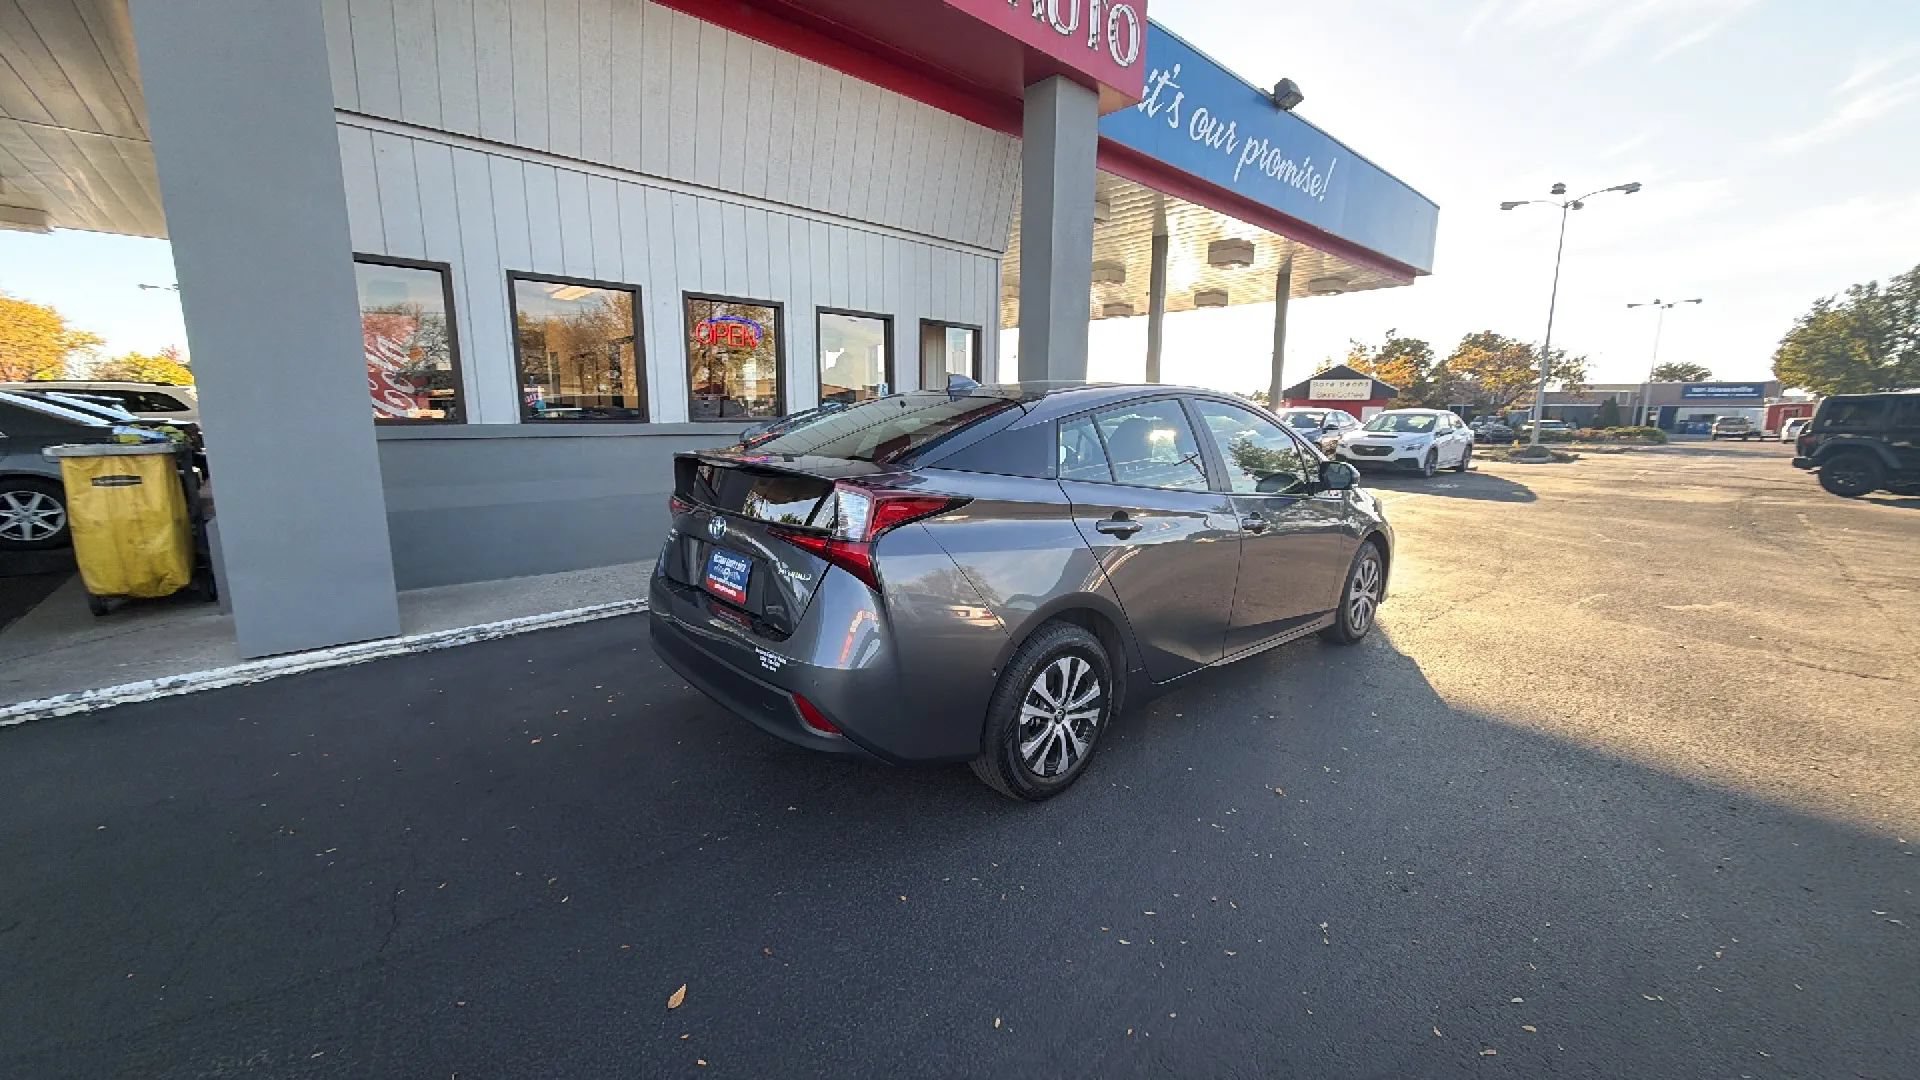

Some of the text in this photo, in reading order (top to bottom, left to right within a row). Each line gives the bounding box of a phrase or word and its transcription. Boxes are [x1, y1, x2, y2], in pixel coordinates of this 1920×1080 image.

[1138, 63, 1338, 202] it's our promise!
[695, 321, 757, 349] OPEN
